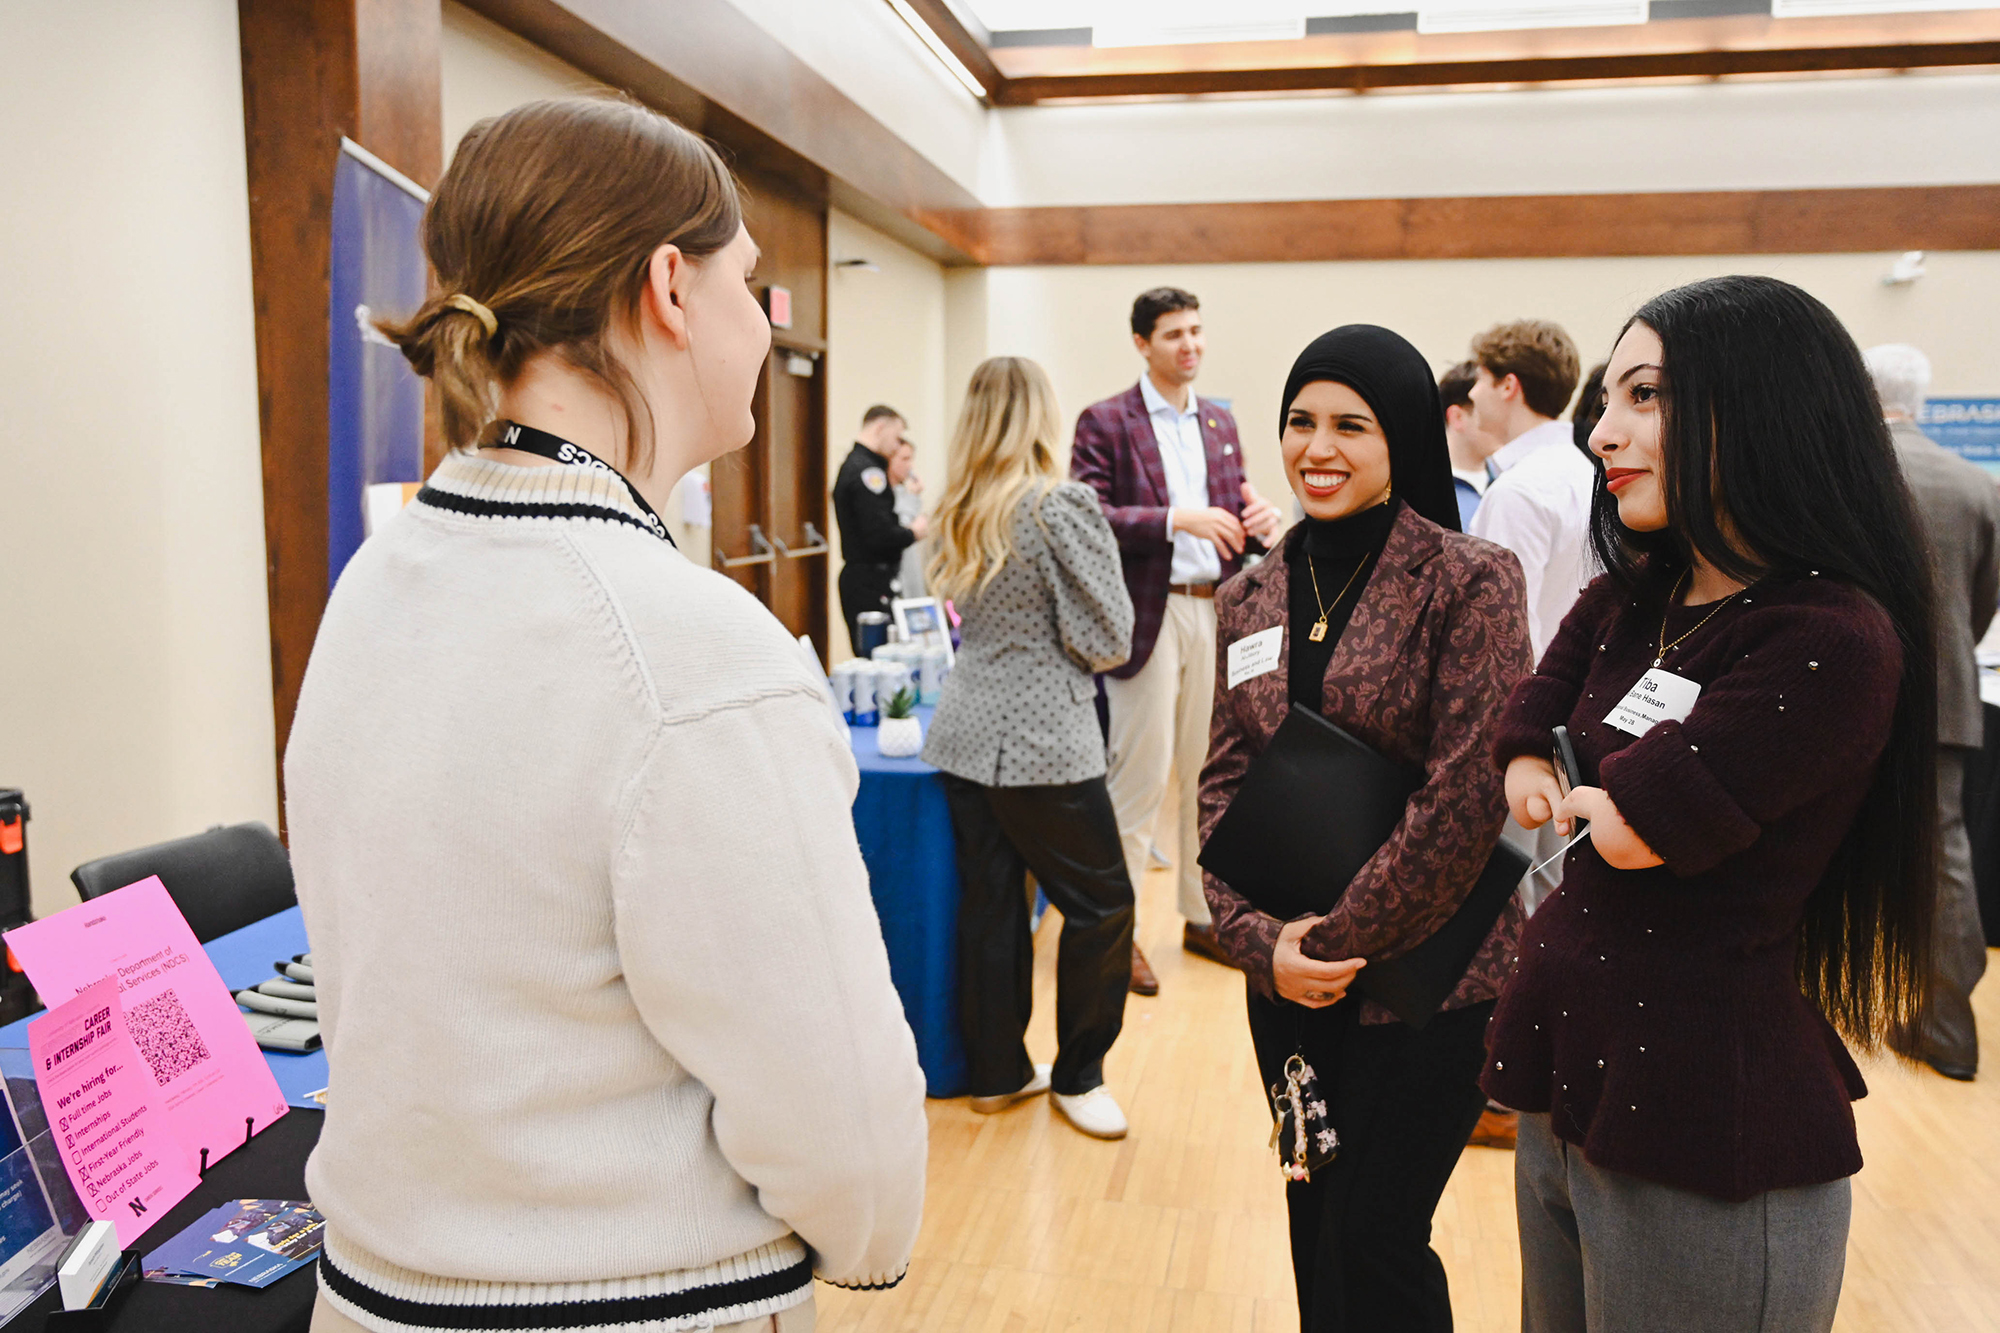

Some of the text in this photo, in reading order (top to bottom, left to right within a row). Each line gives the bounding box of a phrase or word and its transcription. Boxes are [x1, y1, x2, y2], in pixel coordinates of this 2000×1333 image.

[504, 426, 521, 445] N
[1640, 677, 1658, 693] Tiba
[1642, 694, 1666, 709] Hasan
[117, 950, 164, 978] Department
[164, 945, 174, 957] of
[125, 967, 161, 989] Services
[160, 953, 190, 973] (NDCS)
[84, 1006, 111, 1031] CAREER
[45, 1058, 52, 1071] &
[53, 1030, 95, 1066] INTERNSHIP
[96, 1020, 112, 1039] FAIR
[57, 1065, 124, 1110] We're hiring for...
[68, 1089, 112, 1123] Full time Jobs
[74, 1110, 111, 1140] Internships
[81, 1105, 147, 1156] International Students
[88, 1127, 145, 1172] First-Year Friendly
[96, 1150, 143, 1188] Nebraska Jobs
[105, 1190, 120, 1204] Out
[119, 1183, 127, 1194] of
[125, 1171, 144, 1188] State
[144, 1159, 159, 1175] Jobs
[128, 1196, 147, 1218] N
